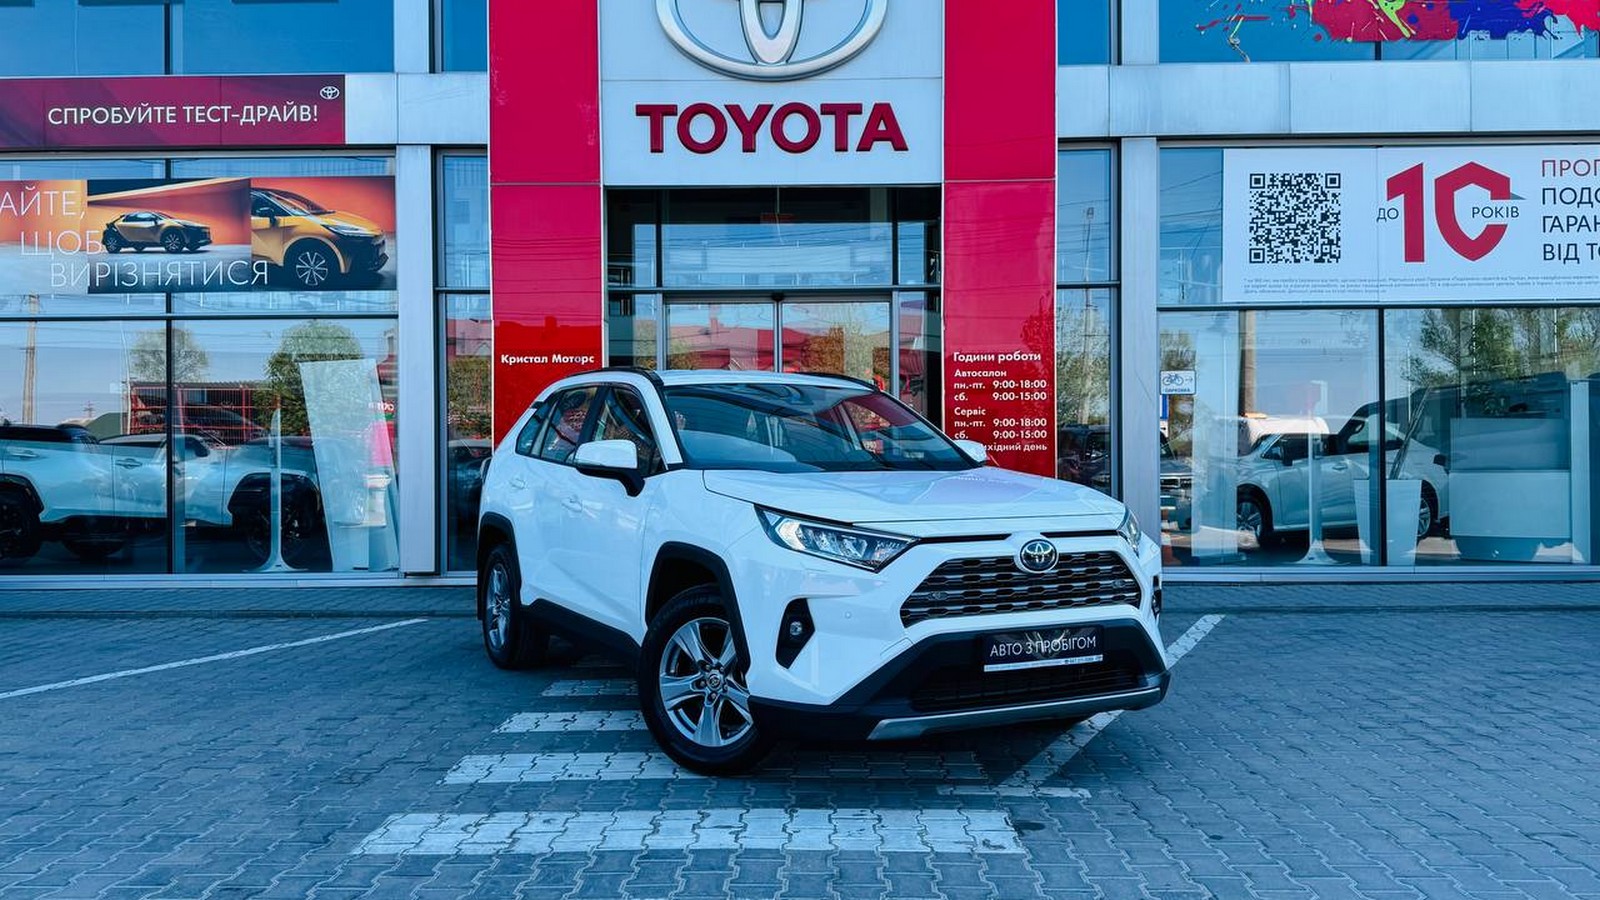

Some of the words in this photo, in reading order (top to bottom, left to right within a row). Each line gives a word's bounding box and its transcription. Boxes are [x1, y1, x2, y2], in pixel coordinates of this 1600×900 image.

[48, 103, 177, 126] СПРОБУЙТЕ
[183, 100, 319, 125] ТЕСТ-ДРАЙВ!
[635, 102, 909, 154] TOYOTA
[1376, 207, 1400, 223] ДО
[1471, 206, 1520, 220] РОКІВ
[20, 230, 103, 259] ЩОБ
[1543, 242, 1580, 265] ВІД
[50, 260, 270, 289] ВИРІЗНЯТИСЯ
[501, 354, 548, 365] Кристал
[552, 354, 594, 365] Моторс
[954, 352, 994, 363] Години
[998, 351, 1041, 363] роботи
[954, 369, 1006, 377] Автосалон
[993, 380, 1046, 389] 9:00-18:00
[954, 393, 968, 401] сб.
[993, 392, 1046, 401] 9:00-15:00
[954, 407, 986, 417] Сервіс
[993, 418, 1047, 428] 9:00-18:00
[954, 431, 969, 439] сб.
[993, 430, 1047, 439] 9:00-15:00
[1023, 443, 1048, 453] день
[989, 643, 1022, 657] АВТО
[1035, 635, 1097, 654] ПРОБІГОМ
